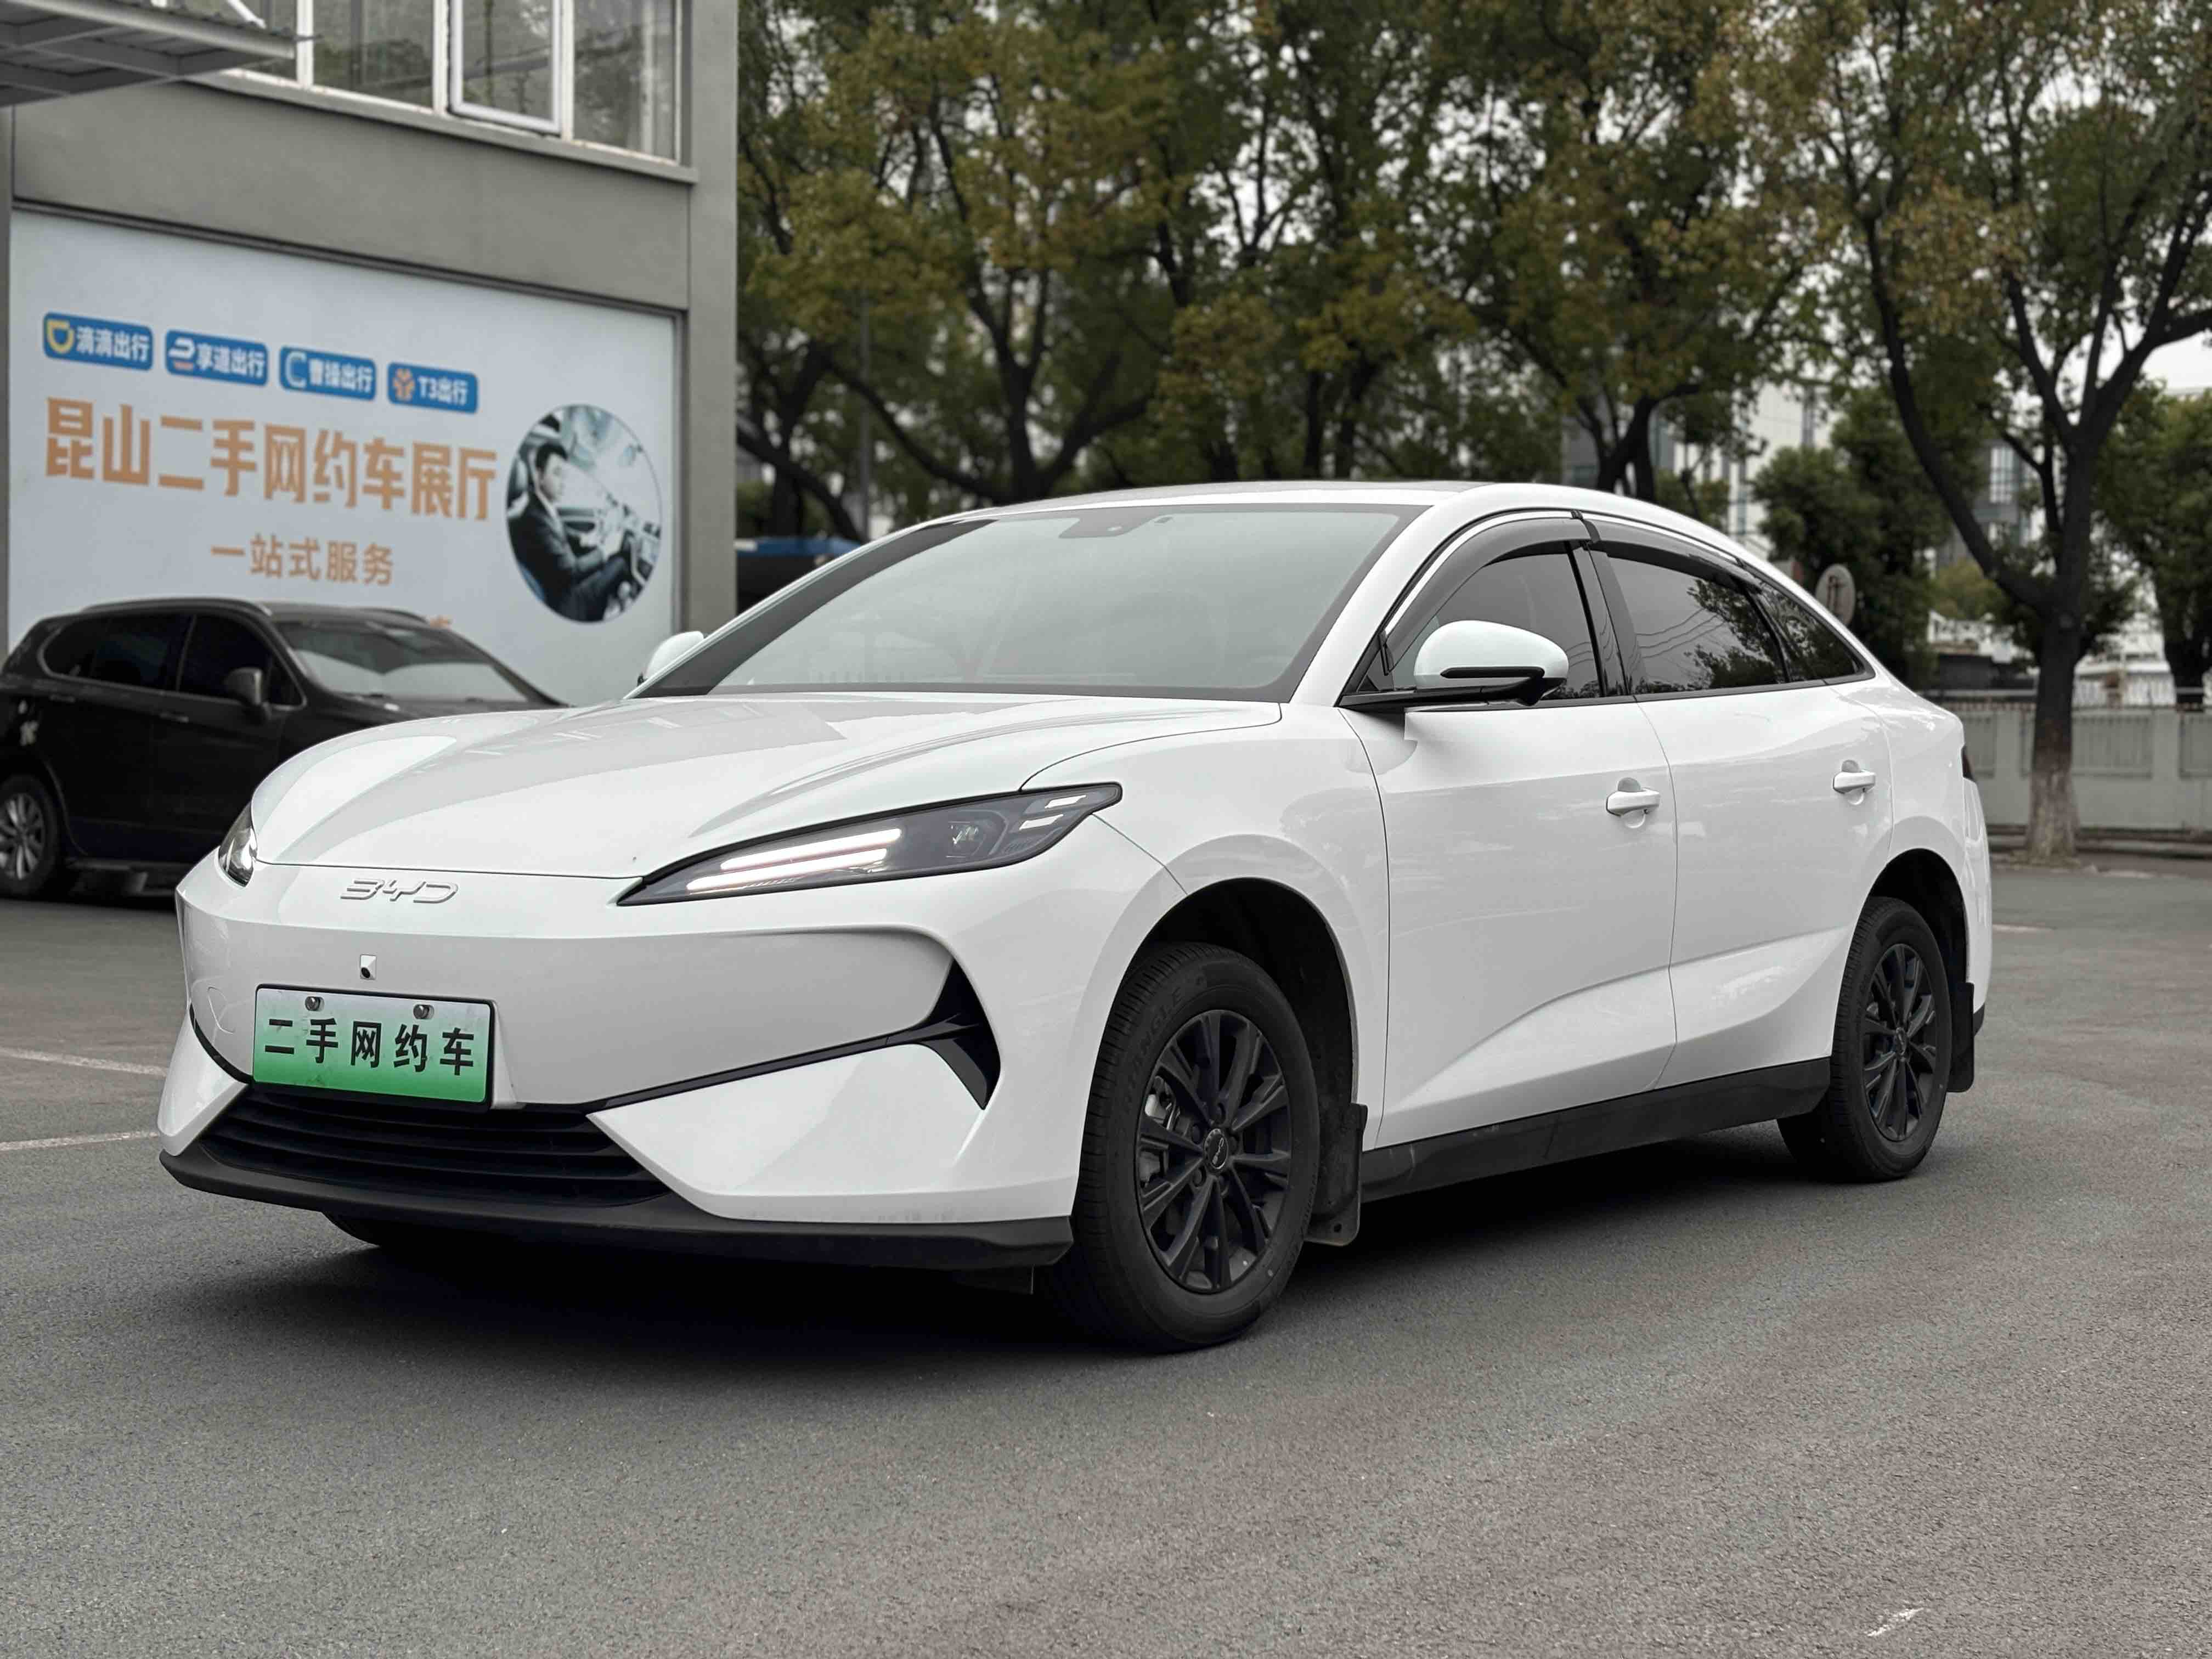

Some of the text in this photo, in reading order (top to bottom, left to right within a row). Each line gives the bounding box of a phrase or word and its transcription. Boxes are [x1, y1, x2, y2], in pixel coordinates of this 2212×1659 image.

[76, 326, 149, 362] 滴滴出行
[196, 342, 264, 379] 享道出行
[417, 375, 469, 406] T3出行
[46, 397, 497, 521] 昆山二手网约车展厅
[211, 533, 394, 586] 一站式服务
[340, 878, 459, 904] BYD
[264, 1018, 475, 1076] 二手网约车
